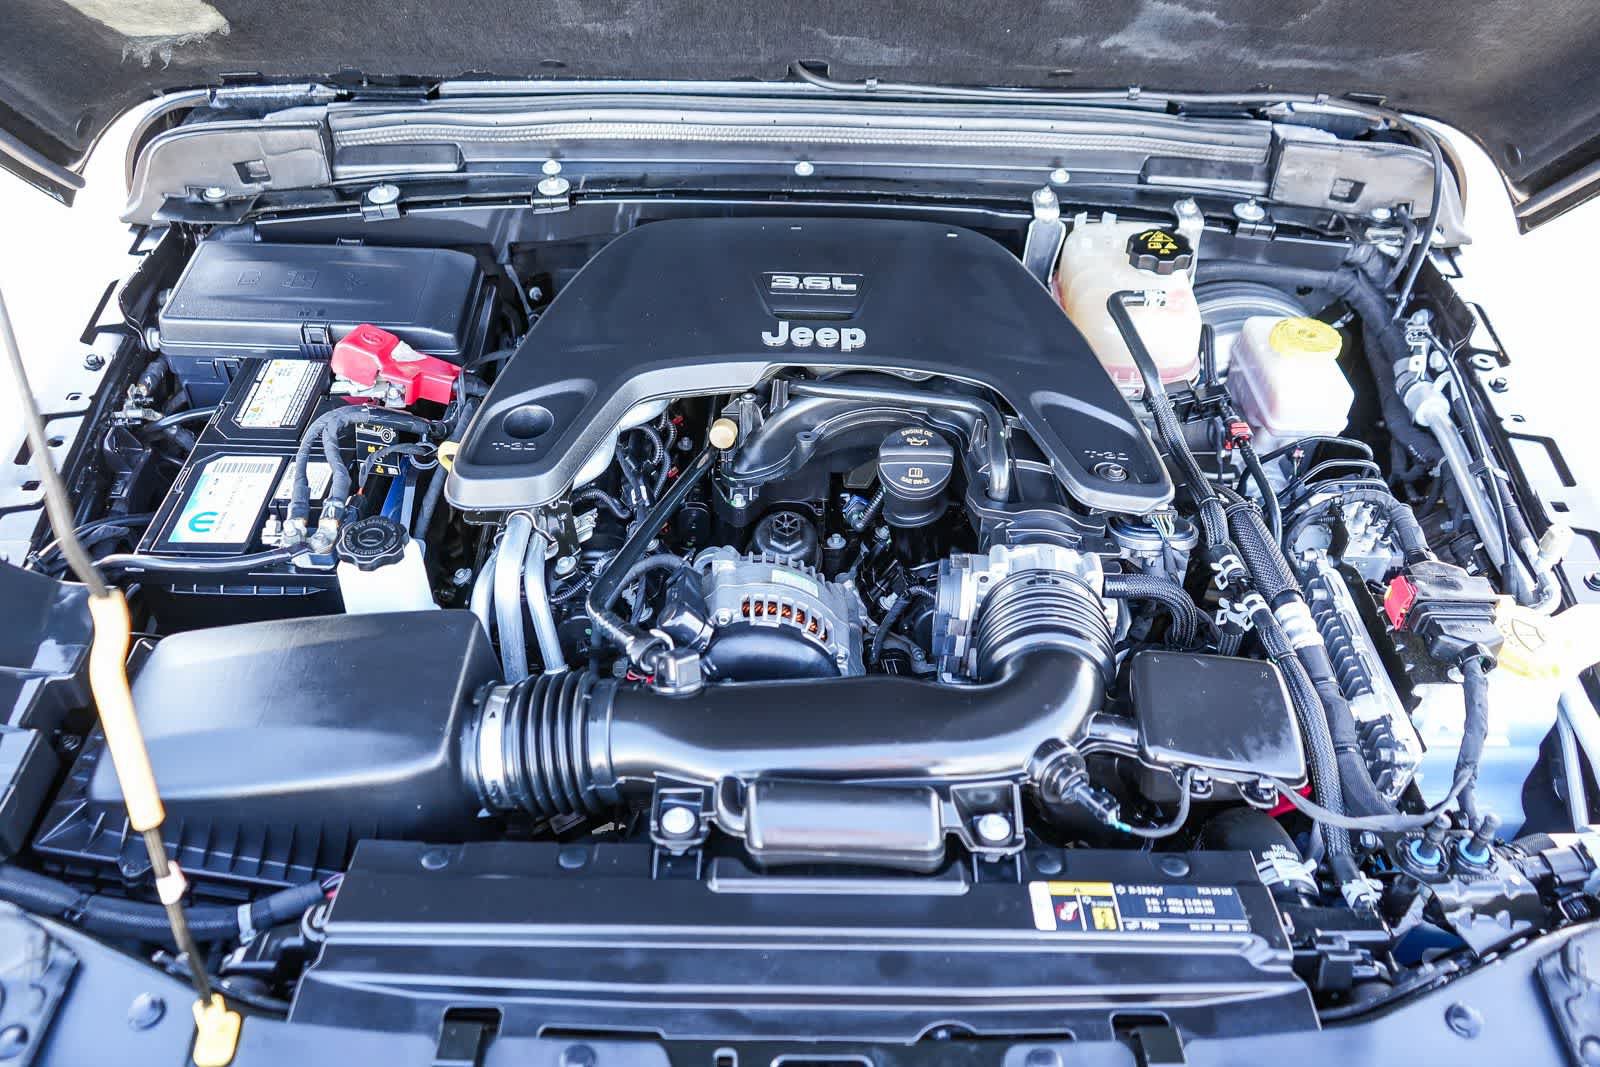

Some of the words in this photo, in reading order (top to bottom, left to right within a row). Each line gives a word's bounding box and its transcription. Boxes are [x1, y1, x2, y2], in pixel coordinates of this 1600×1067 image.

[770, 275, 857, 290] 3.6L
[761, 320, 867, 352] Jeep
[901, 428, 924, 437] ENGINE
